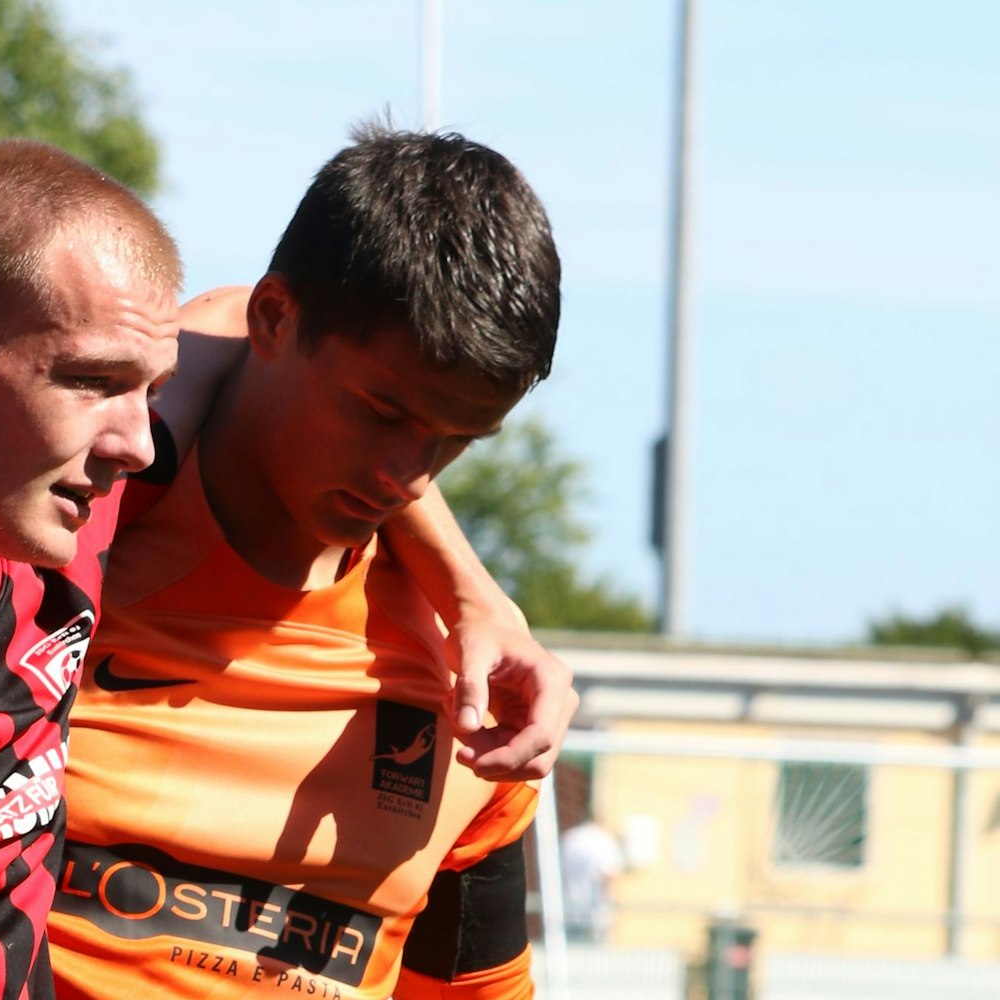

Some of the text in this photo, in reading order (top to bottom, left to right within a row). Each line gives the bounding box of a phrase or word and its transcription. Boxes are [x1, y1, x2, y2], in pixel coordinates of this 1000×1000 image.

[61, 860, 365, 965] L'OSTERIA
[170, 945, 238, 977] PIZZA
[252, 966, 264, 983] E
